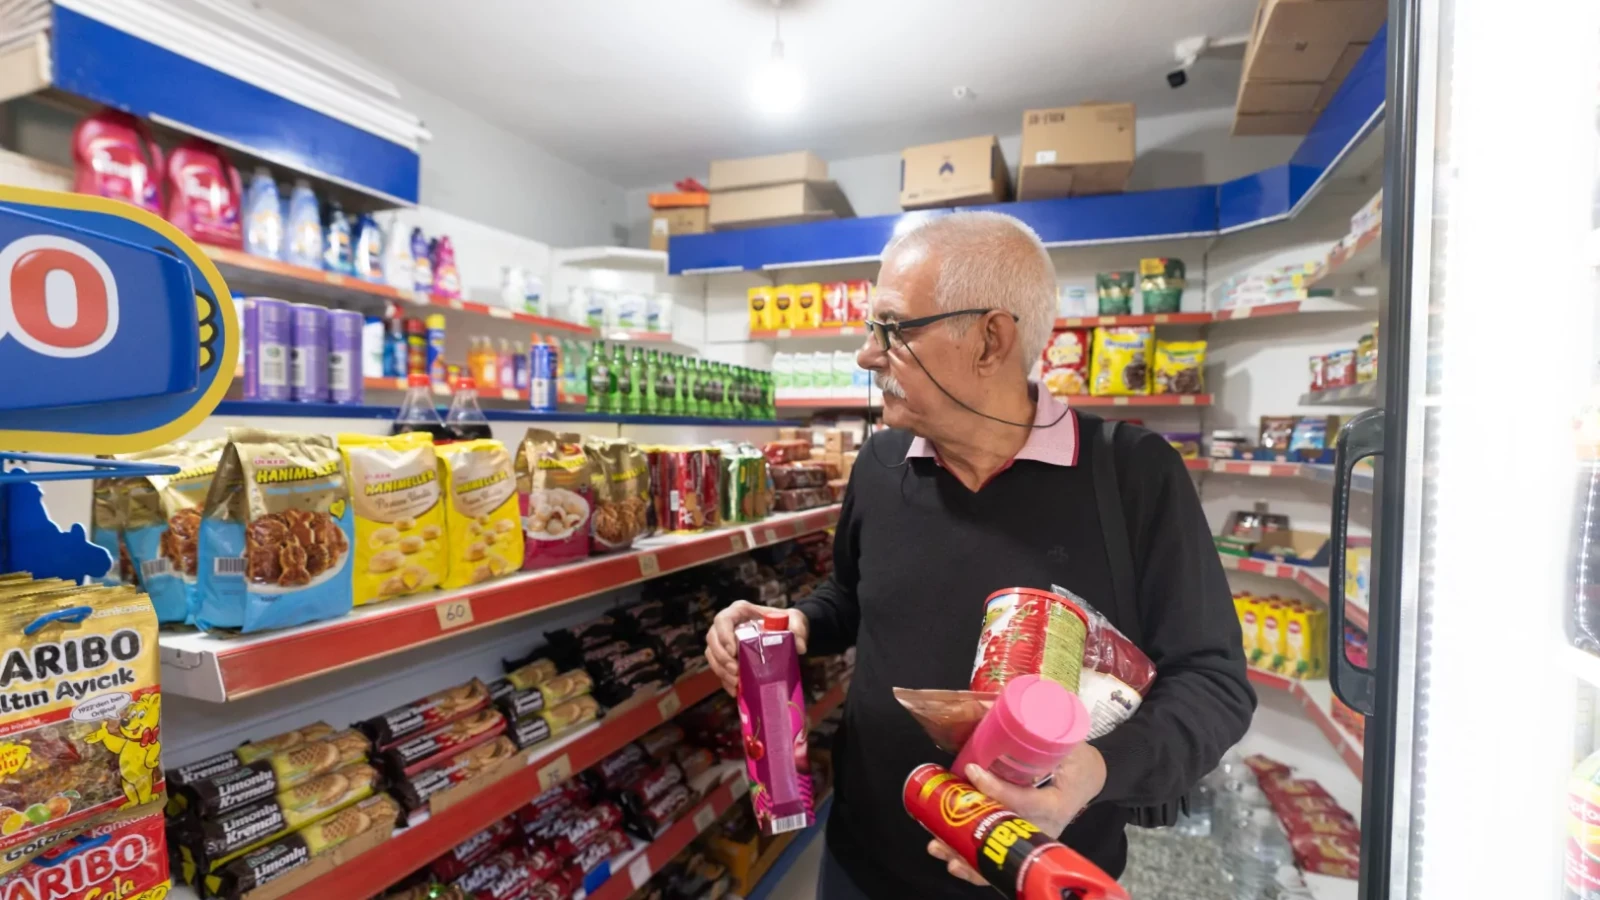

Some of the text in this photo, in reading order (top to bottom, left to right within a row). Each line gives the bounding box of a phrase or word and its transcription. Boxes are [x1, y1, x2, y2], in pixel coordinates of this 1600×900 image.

[446, 604, 465, 621] 60
[0, 630, 140, 687] ARIBO
[0, 667, 135, 713] ltın Ayıcık
[218, 770, 273, 797] Limonlu
[222, 803, 279, 833] Limonlu
[254, 846, 307, 879] Limonlu
